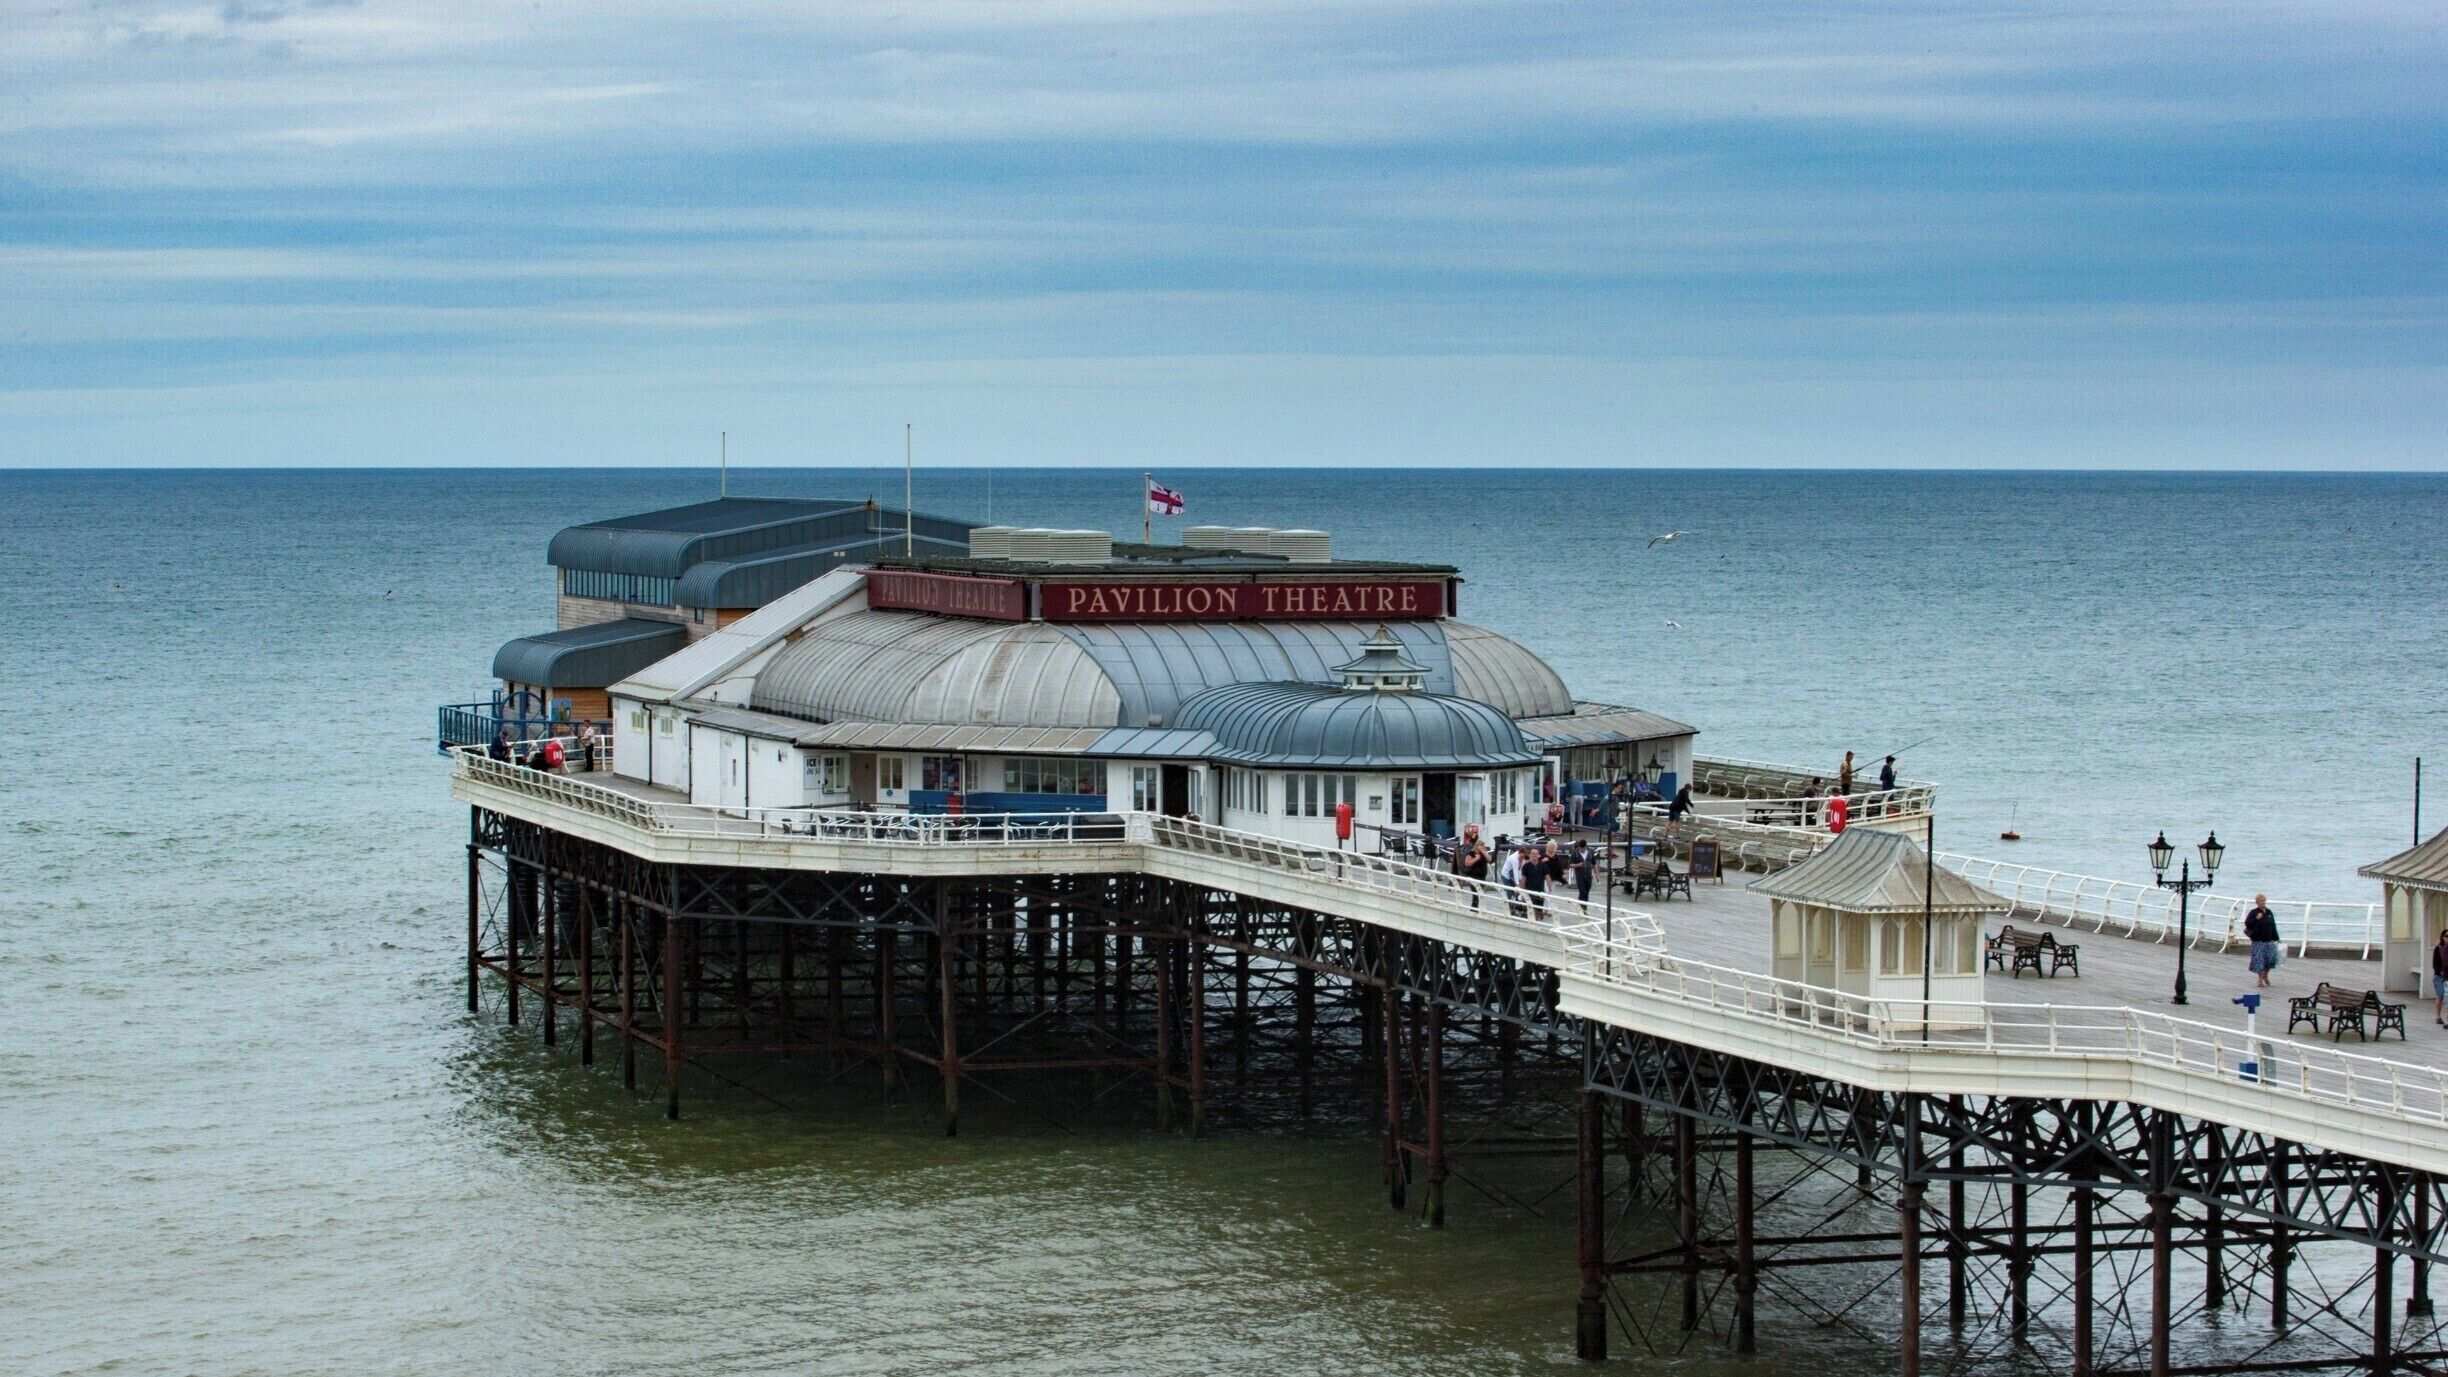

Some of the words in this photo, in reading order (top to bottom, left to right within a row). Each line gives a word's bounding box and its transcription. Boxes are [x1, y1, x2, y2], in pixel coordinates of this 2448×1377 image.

[881, 576, 940, 606] PAVILION
[950, 580, 1005, 613] THEATRE
[1067, 586, 1238, 614] PAVILION
[1261, 585, 1418, 613] THEATRE
[806, 758, 817, 767] ICE
